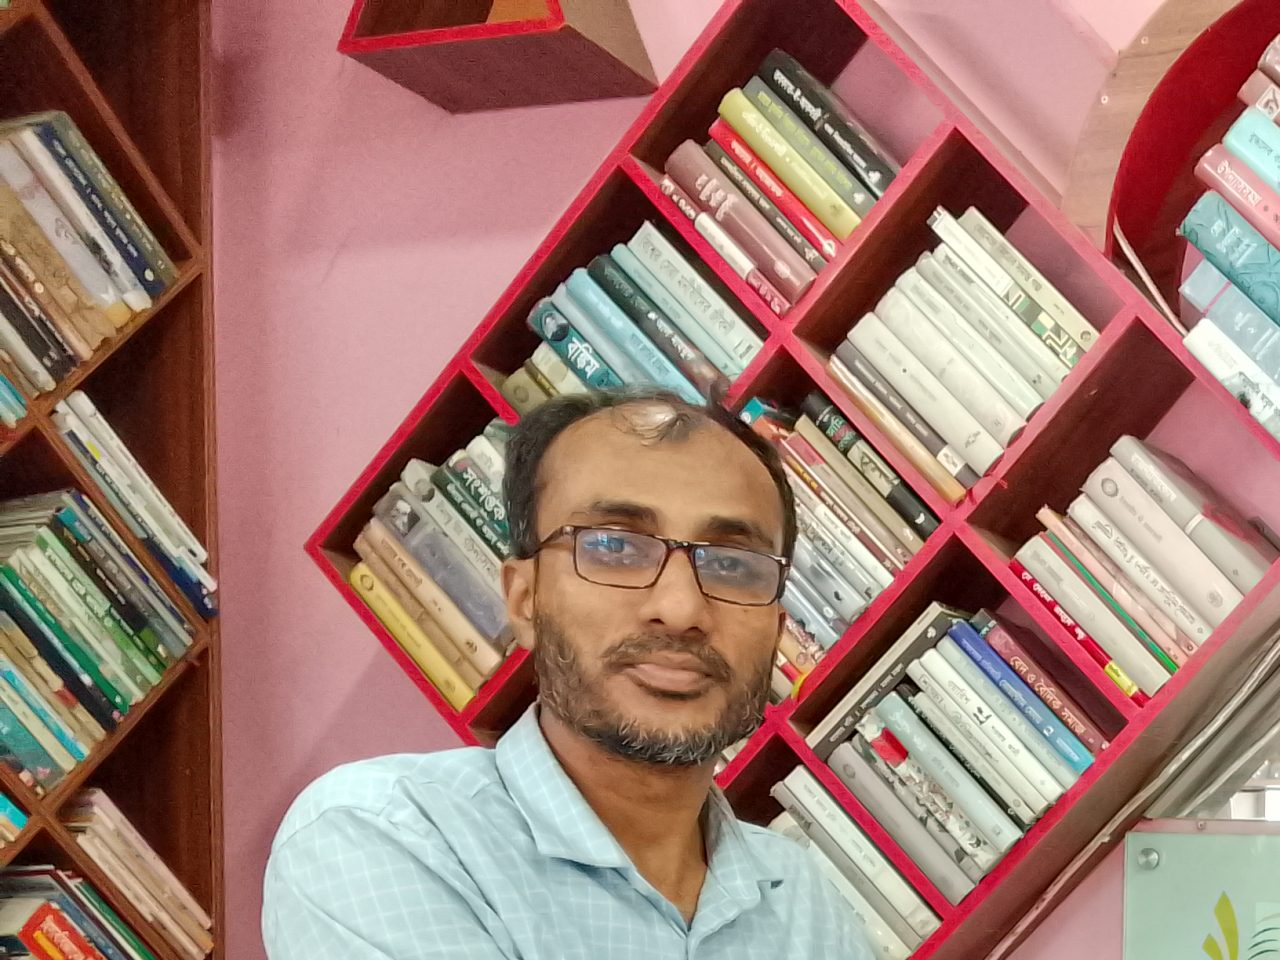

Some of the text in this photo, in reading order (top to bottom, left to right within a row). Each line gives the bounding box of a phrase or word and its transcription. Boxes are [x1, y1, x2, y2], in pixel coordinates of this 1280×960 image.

[1007, 654, 1087, 736] বেদ ও বৈদিক সমাজ
